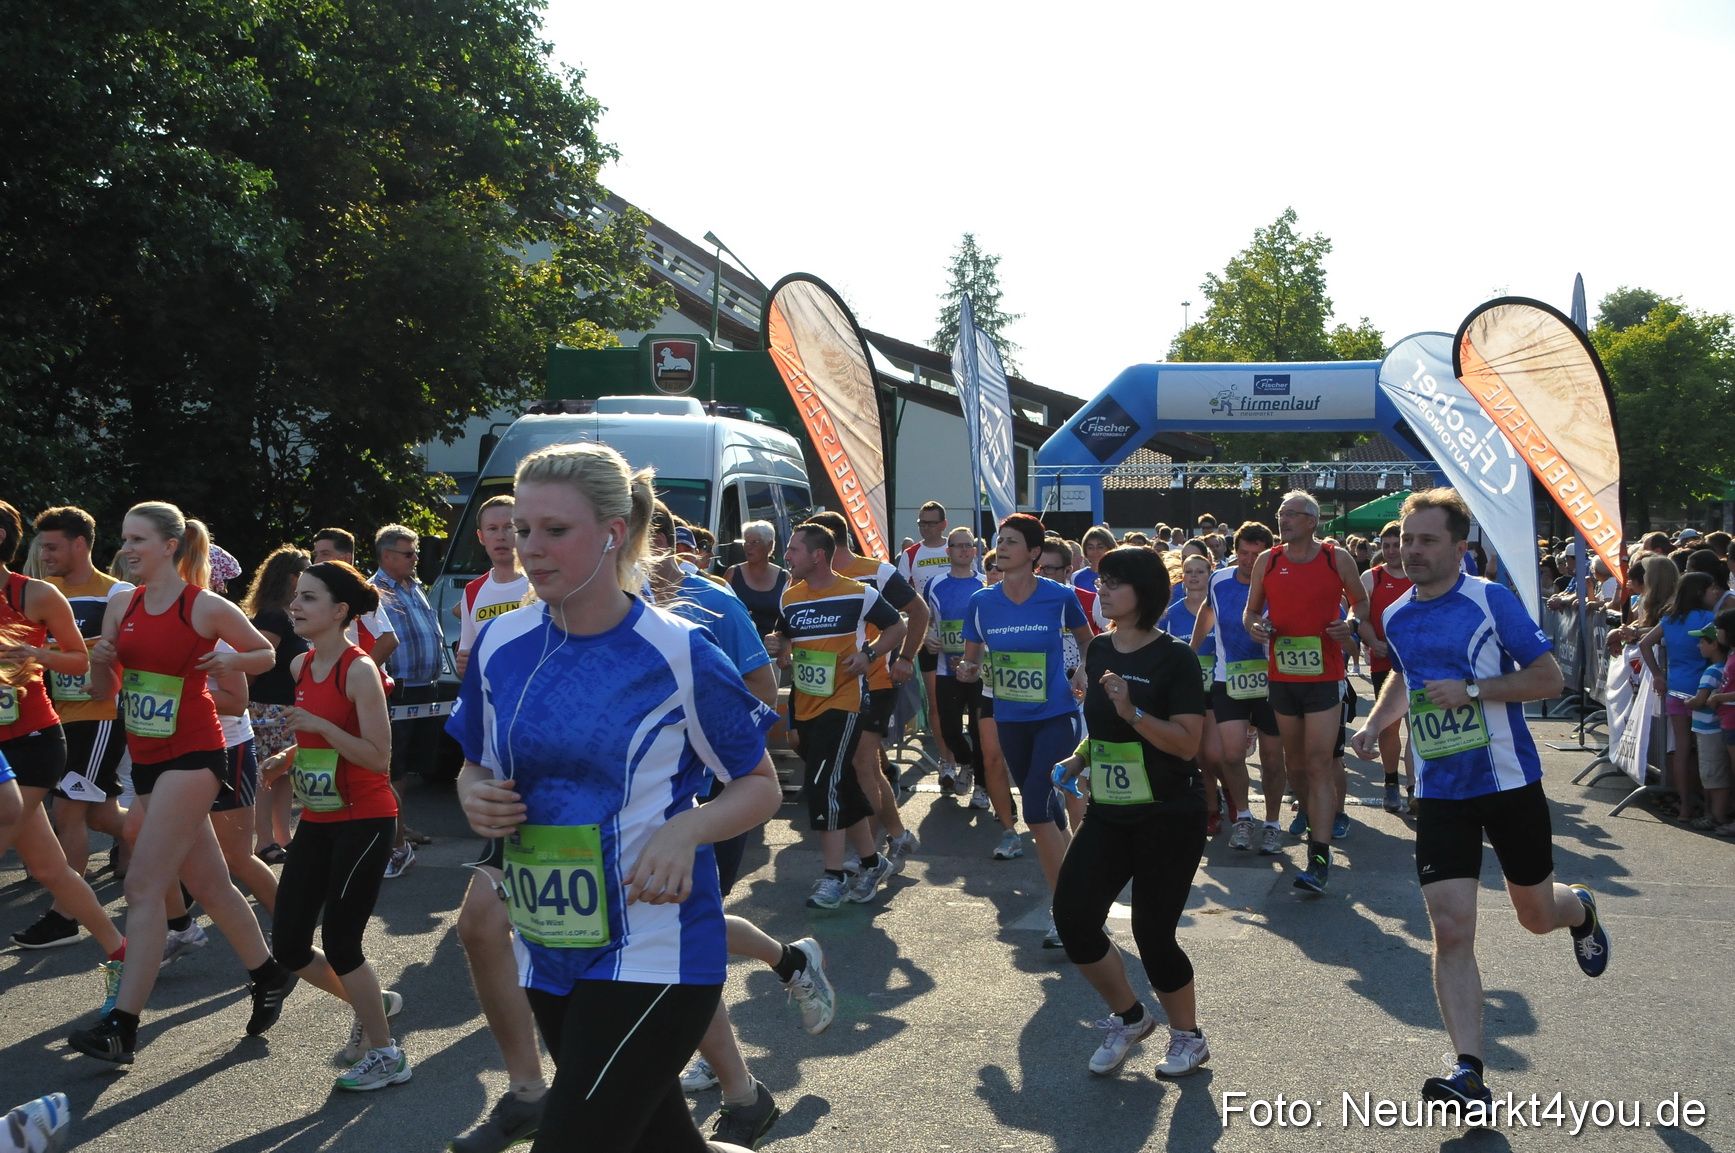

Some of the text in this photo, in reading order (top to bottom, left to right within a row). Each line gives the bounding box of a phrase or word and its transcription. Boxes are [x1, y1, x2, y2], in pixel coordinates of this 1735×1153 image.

[1240, 395, 1321, 411] firmenlauf
[1087, 423, 1131, 433] Fischer
[796, 614, 841, 626] Fischer
[986, 624, 1048, 635] energiegeladen
[1276, 650, 1321, 667] 1313
[797, 663, 826, 685] 393
[995, 668, 1043, 690] 1266
[1228, 672, 1268, 691] 1039
[124, 691, 174, 722] 1304
[1412, 704, 1480, 742] 1042
[291, 766, 336, 797] 1322
[1100, 763, 1130, 789] 78
[505, 863, 598, 916] 1040
